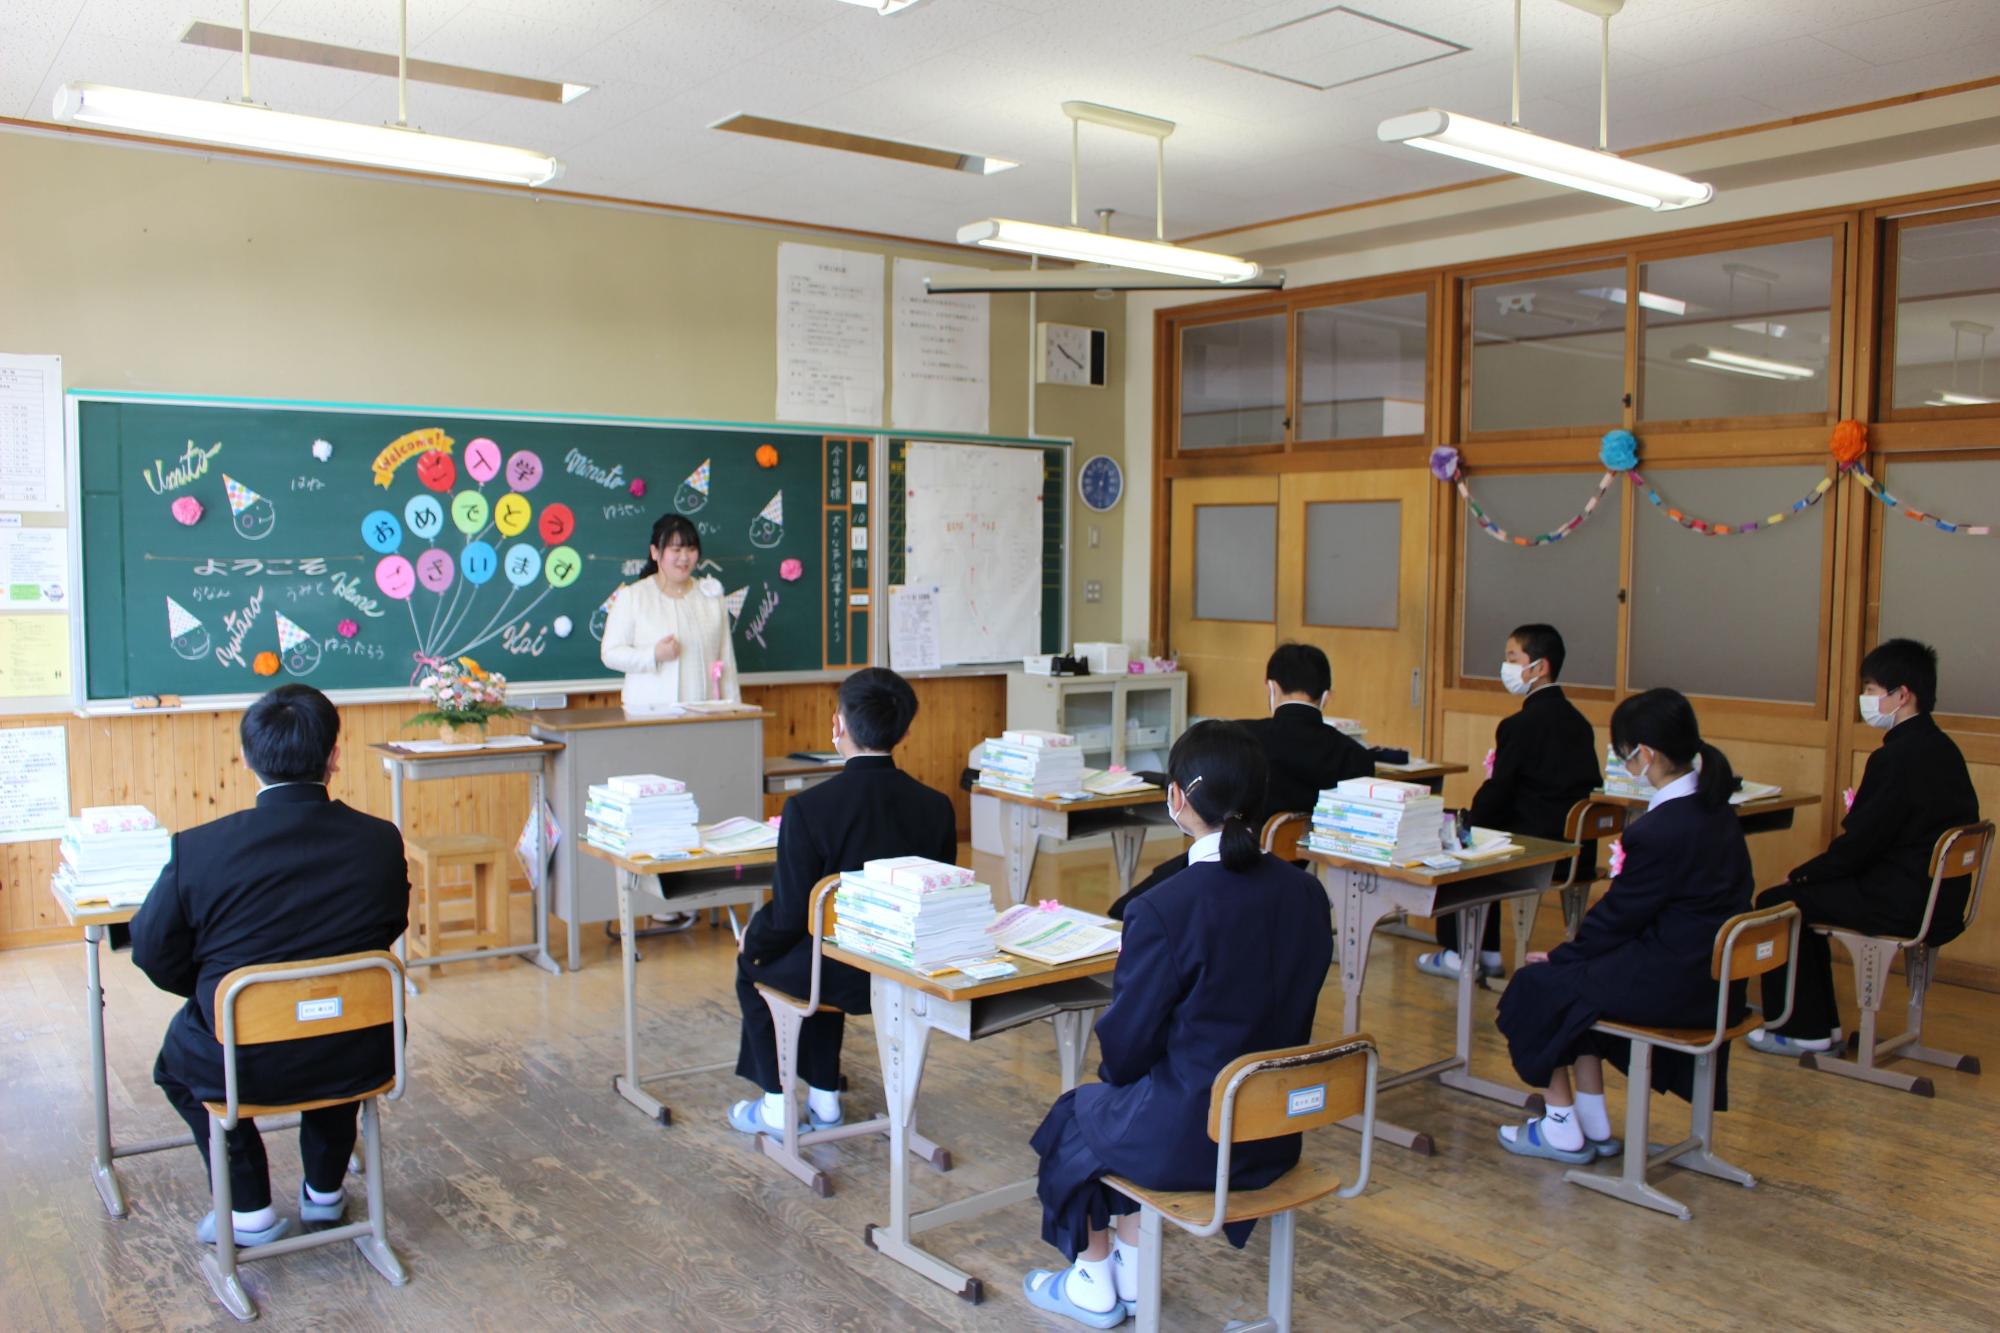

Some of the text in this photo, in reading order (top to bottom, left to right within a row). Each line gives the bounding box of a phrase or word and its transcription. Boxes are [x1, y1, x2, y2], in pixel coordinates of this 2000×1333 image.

[378, 432, 442, 471] Welcome!
[565, 447, 627, 490] Minato
[193, 558, 328, 576] ようこそ
[502, 621, 548, 656] Kai
